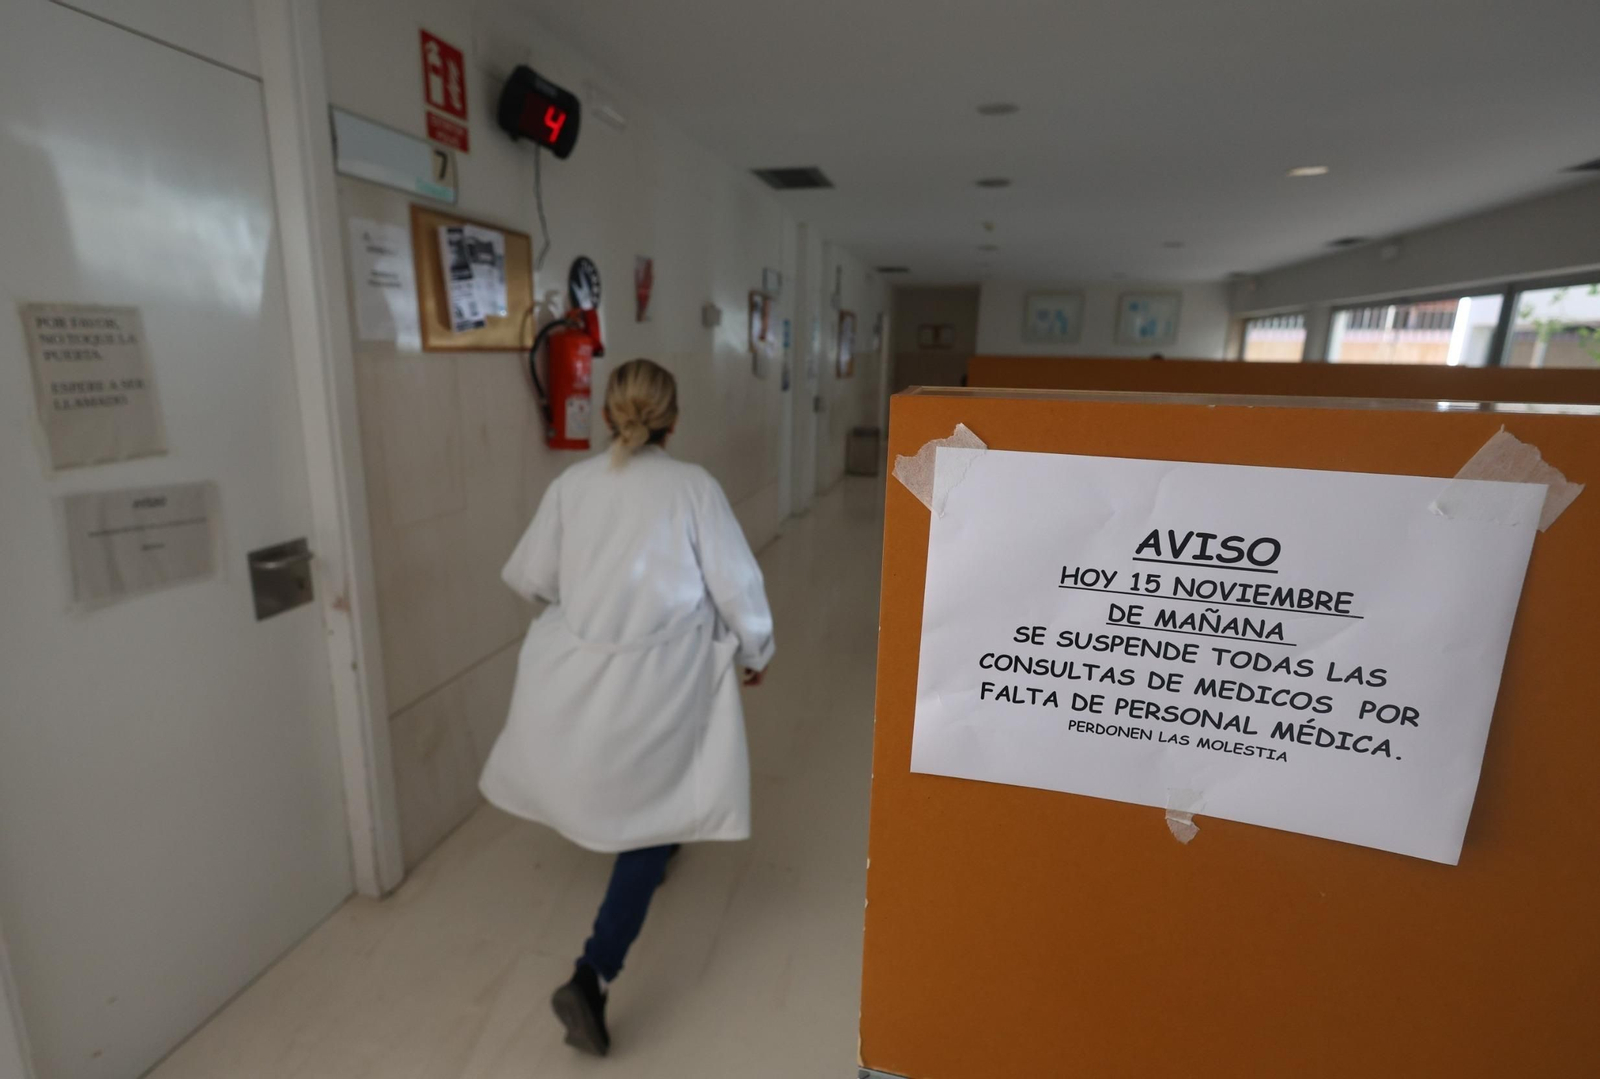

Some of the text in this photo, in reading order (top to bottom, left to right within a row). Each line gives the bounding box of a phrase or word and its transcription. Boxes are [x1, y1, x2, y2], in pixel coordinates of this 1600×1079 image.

[543, 105, 567, 144] 4
[433, 149, 448, 181] 7
[1134, 528, 1282, 568] AVISO
[1060, 565, 1355, 615] HOY 15 NOVIEMBRE
[1107, 602, 1284, 641] DE MAÑANA
[1013, 625, 1388, 688] SE SUSPENDE TODAS LAS
[979, 652, 1420, 728] CONSULTAS DE MEDICOS POR
[980, 681, 1403, 761] FALTA DE PERSONAL MÉDICA.
[1068, 719, 1288, 763] PERDONEN LAS MOLESTIA
